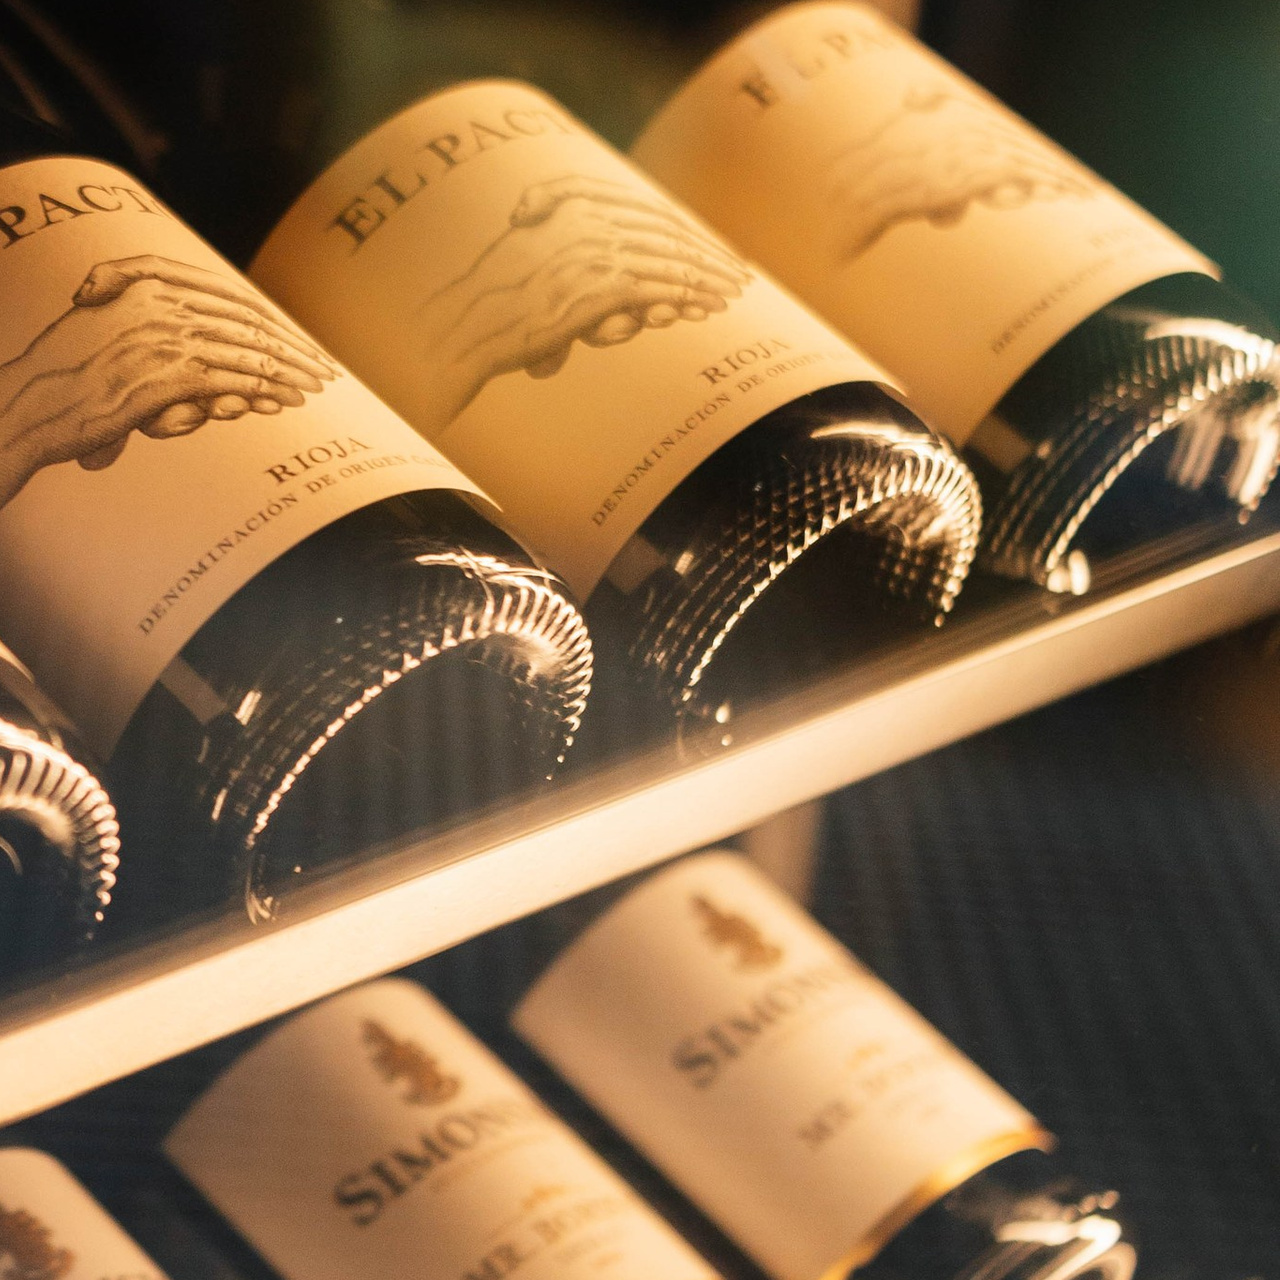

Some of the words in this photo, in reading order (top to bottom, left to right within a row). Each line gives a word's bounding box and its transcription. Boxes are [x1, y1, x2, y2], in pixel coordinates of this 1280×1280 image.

[326, 171, 428, 257] EL
[697, 334, 791, 388] RIOJA
[264, 433, 374, 490] RIOJA
[591, 390, 732, 528] DENOMINACIÓN
[735, 374, 769, 396] DE
[137, 492, 300, 637] DENOMINACIÓN
[305, 472, 337, 496] DE
[338, 453, 408, 482] ORIGEN
